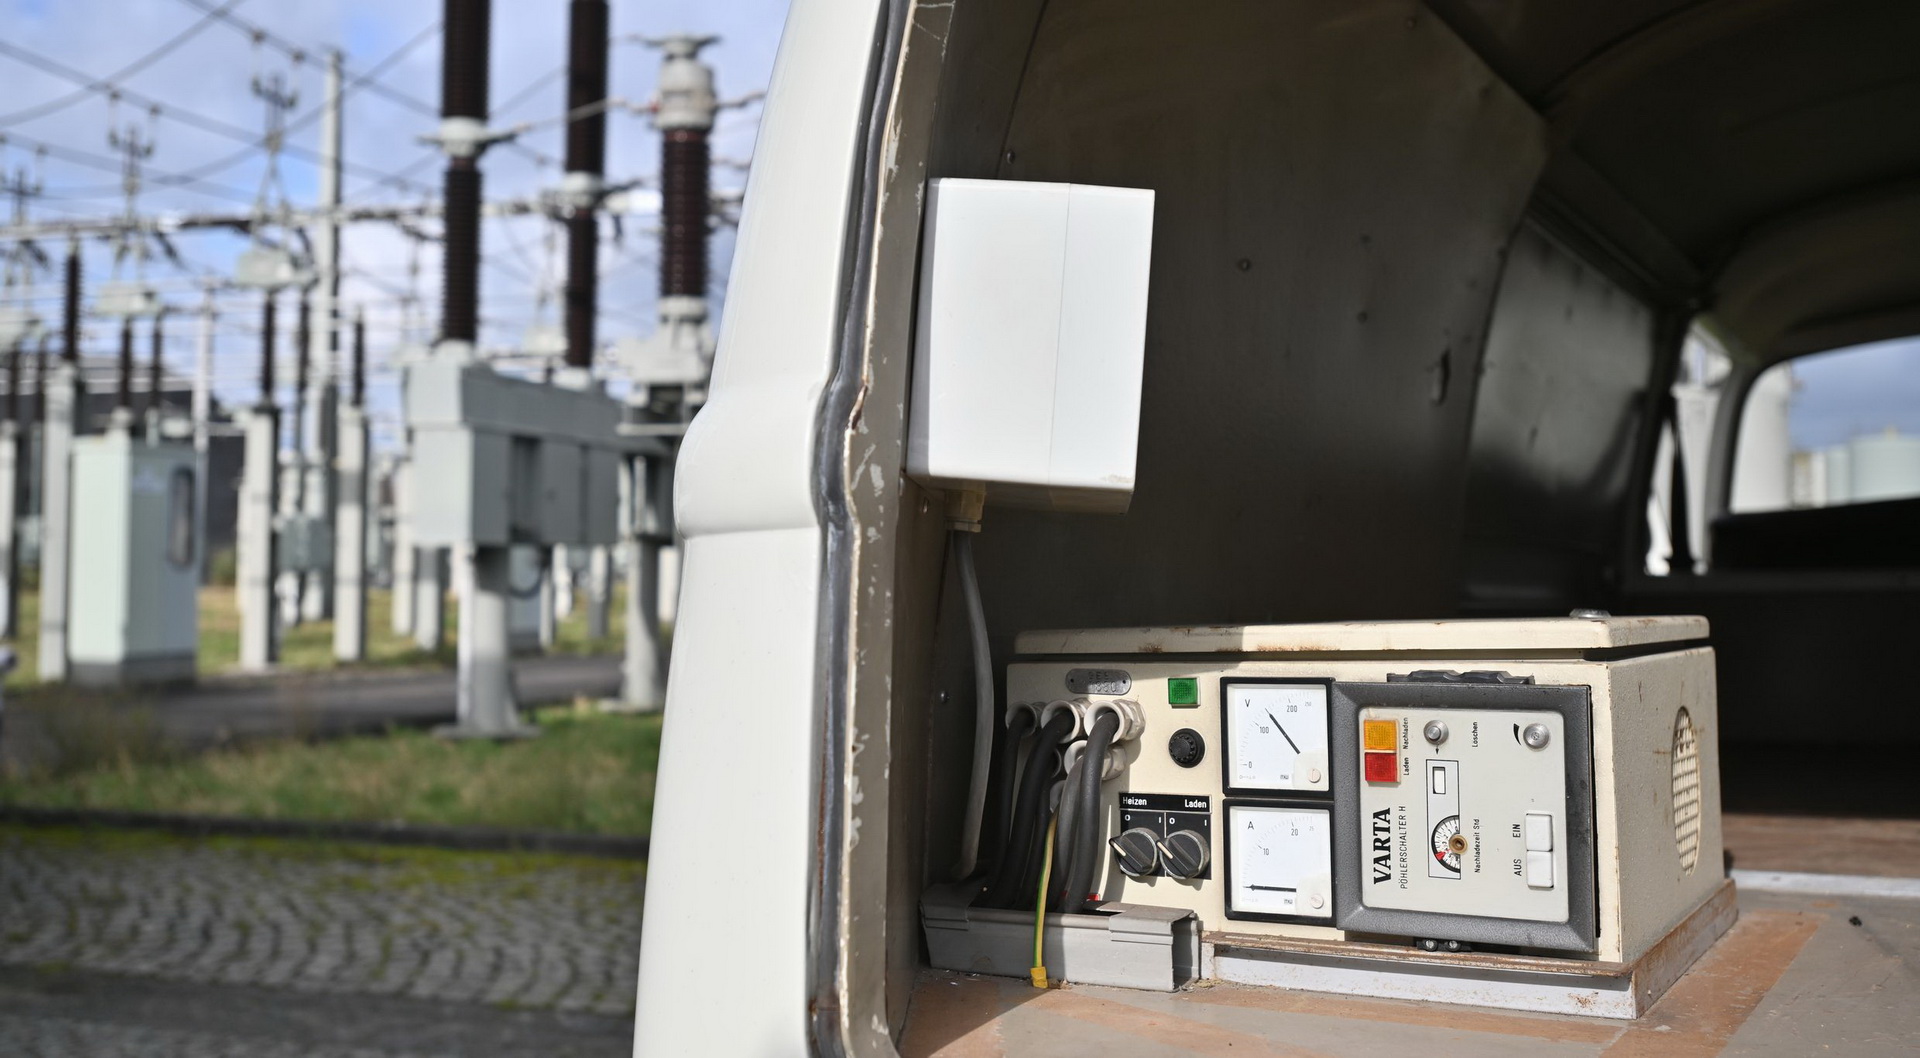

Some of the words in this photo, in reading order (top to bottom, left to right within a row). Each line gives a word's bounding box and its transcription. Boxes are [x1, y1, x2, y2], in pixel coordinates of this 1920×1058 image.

[1244, 699, 1251, 708] V
[1286, 705, 1298, 713] 200
[1259, 726, 1270, 734] 100
[1248, 761, 1253, 769] 0
[1122, 796, 1148, 806] Heizen
[1184, 799, 1207, 808] Laden
[1247, 821, 1255, 830] A
[1291, 828, 1299, 837] 20
[1512, 823, 1521, 838] EIN
[1373, 807, 1392, 885] VARTA
[1263, 848, 1270, 856] 10
[1398, 814, 1408, 889] PÖHLERSCHALTER
[1473, 832, 1481, 874] Nachladezeit
[1513, 858, 1522, 877] AUS
